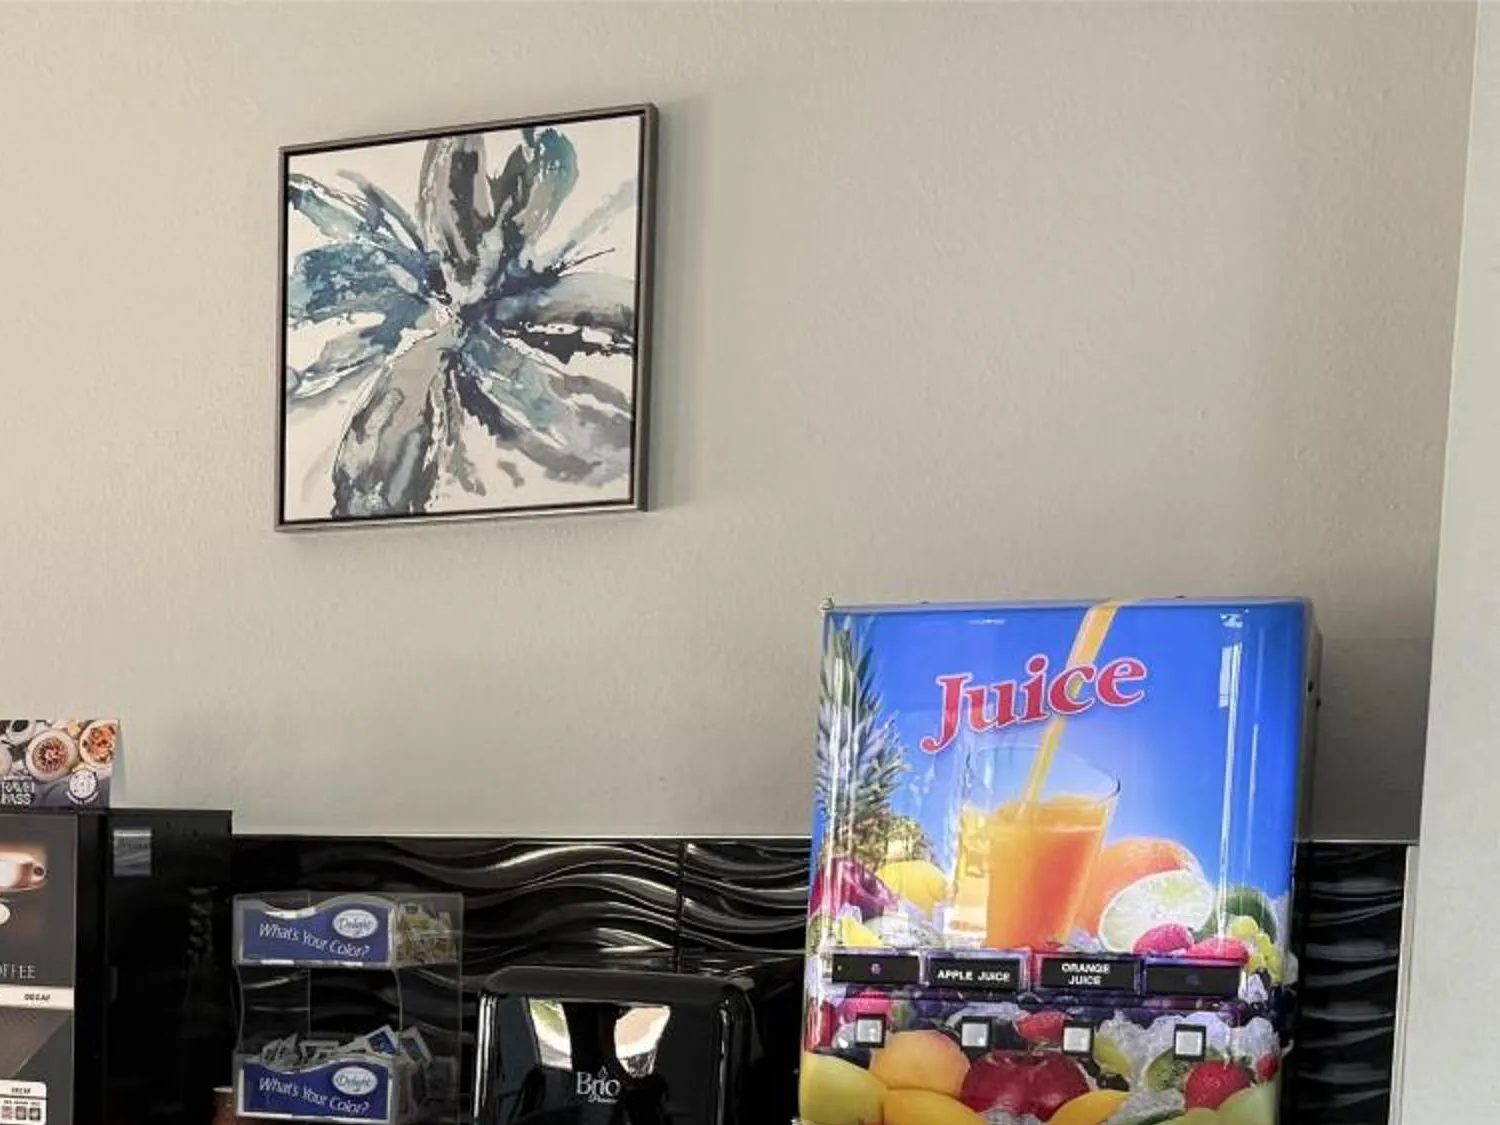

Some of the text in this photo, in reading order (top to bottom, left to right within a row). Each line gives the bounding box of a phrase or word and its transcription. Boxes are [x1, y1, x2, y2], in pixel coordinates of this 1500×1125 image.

[920, 654, 1148, 755] Juice
[259, 922, 371, 957] What's Your Color?
[937, 969, 1011, 983] APPLE JUICE
[1061, 962, 1111, 974] ORANGE
[1068, 975, 1102, 986] JUICE
[259, 1076, 371, 1115] What's Your Color?
[576, 1066, 621, 1097] Brio
